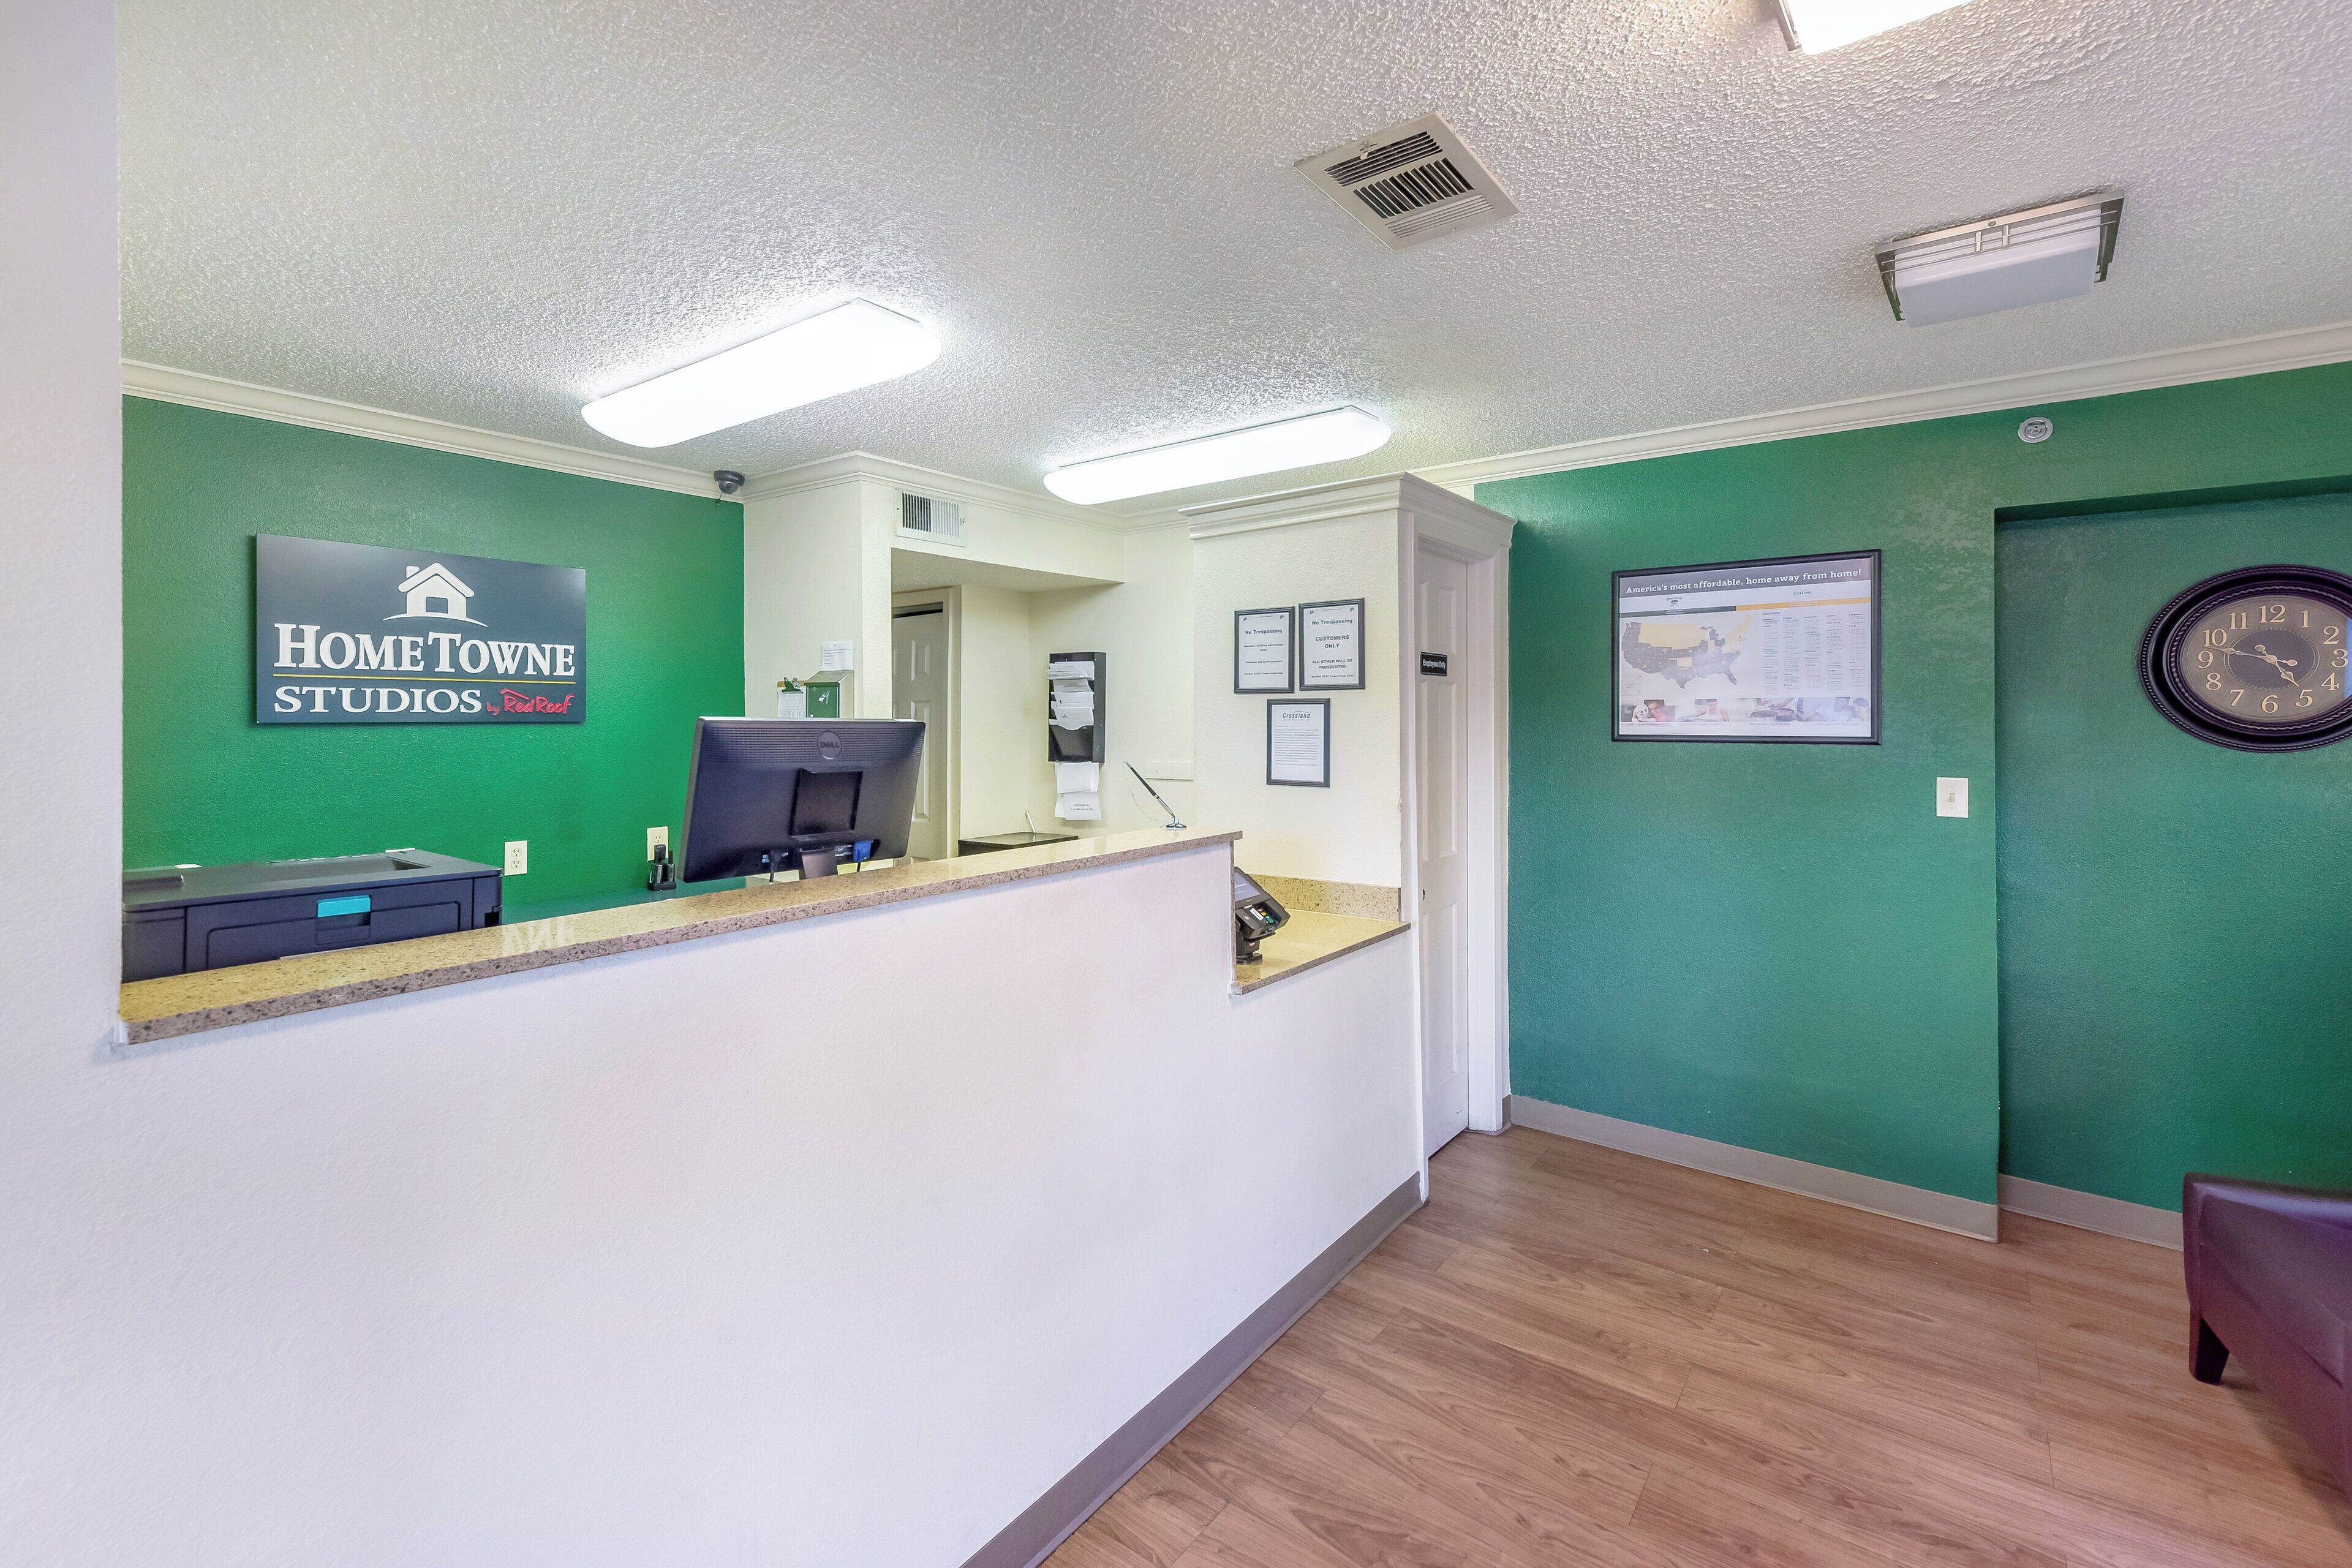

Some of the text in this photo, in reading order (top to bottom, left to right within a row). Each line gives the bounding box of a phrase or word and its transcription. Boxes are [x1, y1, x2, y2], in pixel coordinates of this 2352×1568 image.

[1626, 584, 1668, 594] America's
[1694, 579, 1743, 589] affordable,
[1830, 568, 1862, 578] home!
[2228, 612, 2248, 630] 11
[2259, 604, 2286, 623] 12
[2301, 609, 2310, 628] 1
[2203, 628, 2227, 647] 10
[2323, 625, 2340, 644] 2
[2197, 650, 2214, 669] 9
[2331, 649, 2348, 668] 3
[2206, 673, 2222, 691] 8
[2321, 672, 2339, 691] 4
[274, 686, 482, 713] STUDIOS
[487, 701, 500, 715] by
[2230, 689, 2244, 706] 7
[2261, 695, 2278, 713] 6
[2295, 689, 2313, 707] 5
